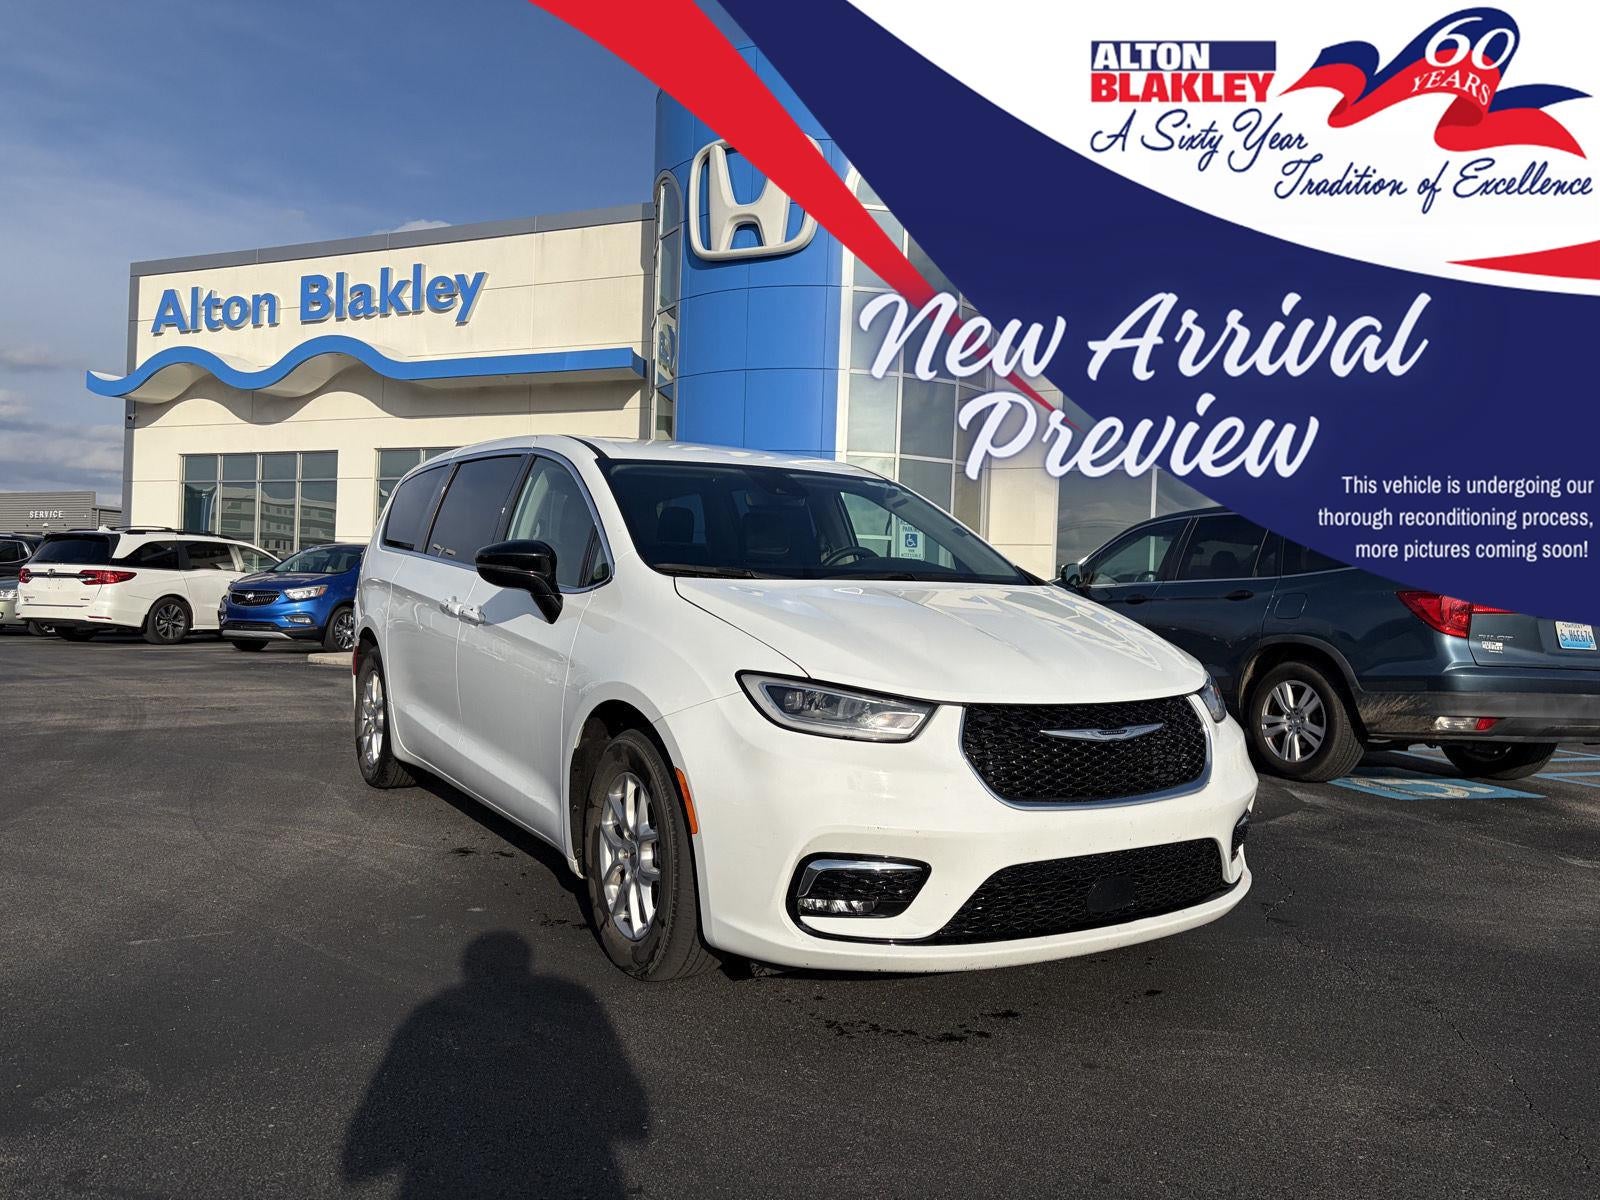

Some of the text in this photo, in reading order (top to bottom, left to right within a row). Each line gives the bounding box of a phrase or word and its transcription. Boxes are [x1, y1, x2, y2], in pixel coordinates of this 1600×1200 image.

[150, 263, 490, 337] Alton Blakley
[29, 510, 64, 519] SERVICE
